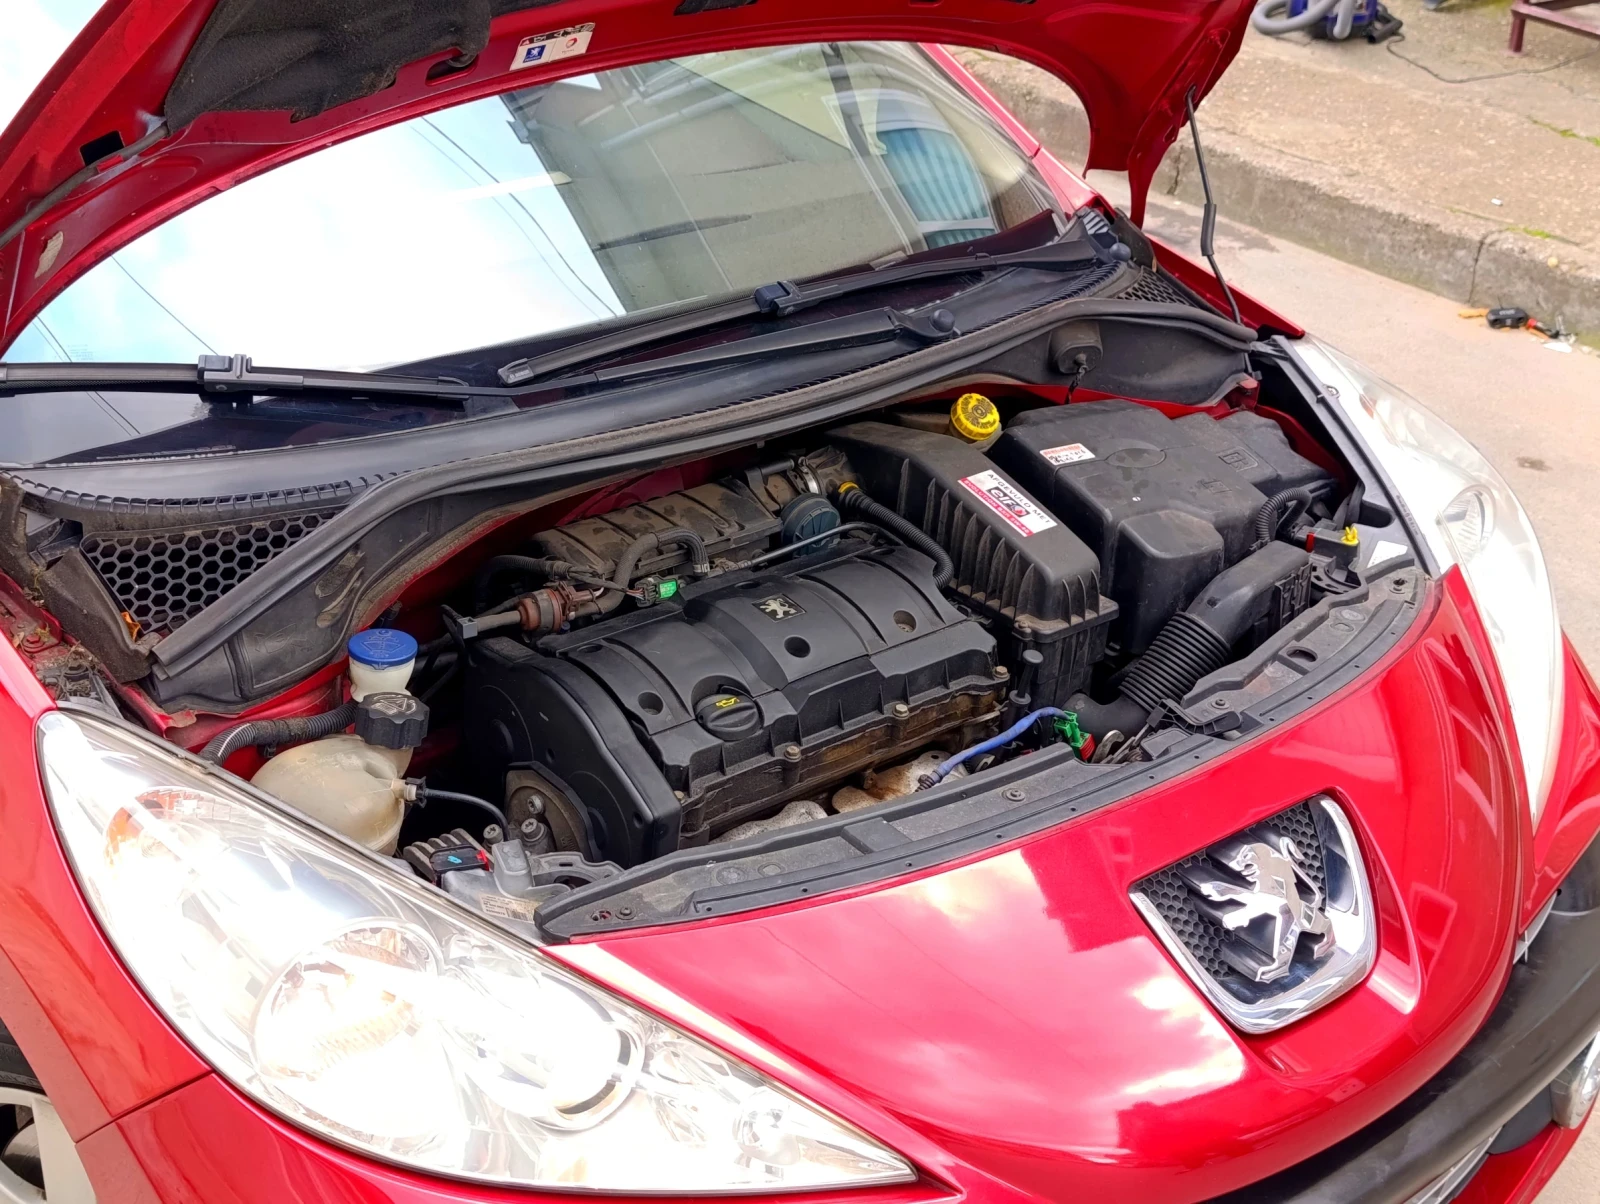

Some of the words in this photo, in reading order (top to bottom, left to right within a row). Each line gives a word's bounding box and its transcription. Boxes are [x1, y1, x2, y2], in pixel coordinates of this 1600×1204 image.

[963, 480, 998, 507] EVOLUTION
[987, 473, 1031, 508] AFGEVULD
[1031, 508, 1051, 523] MET
[990, 488, 1016, 506] elf
